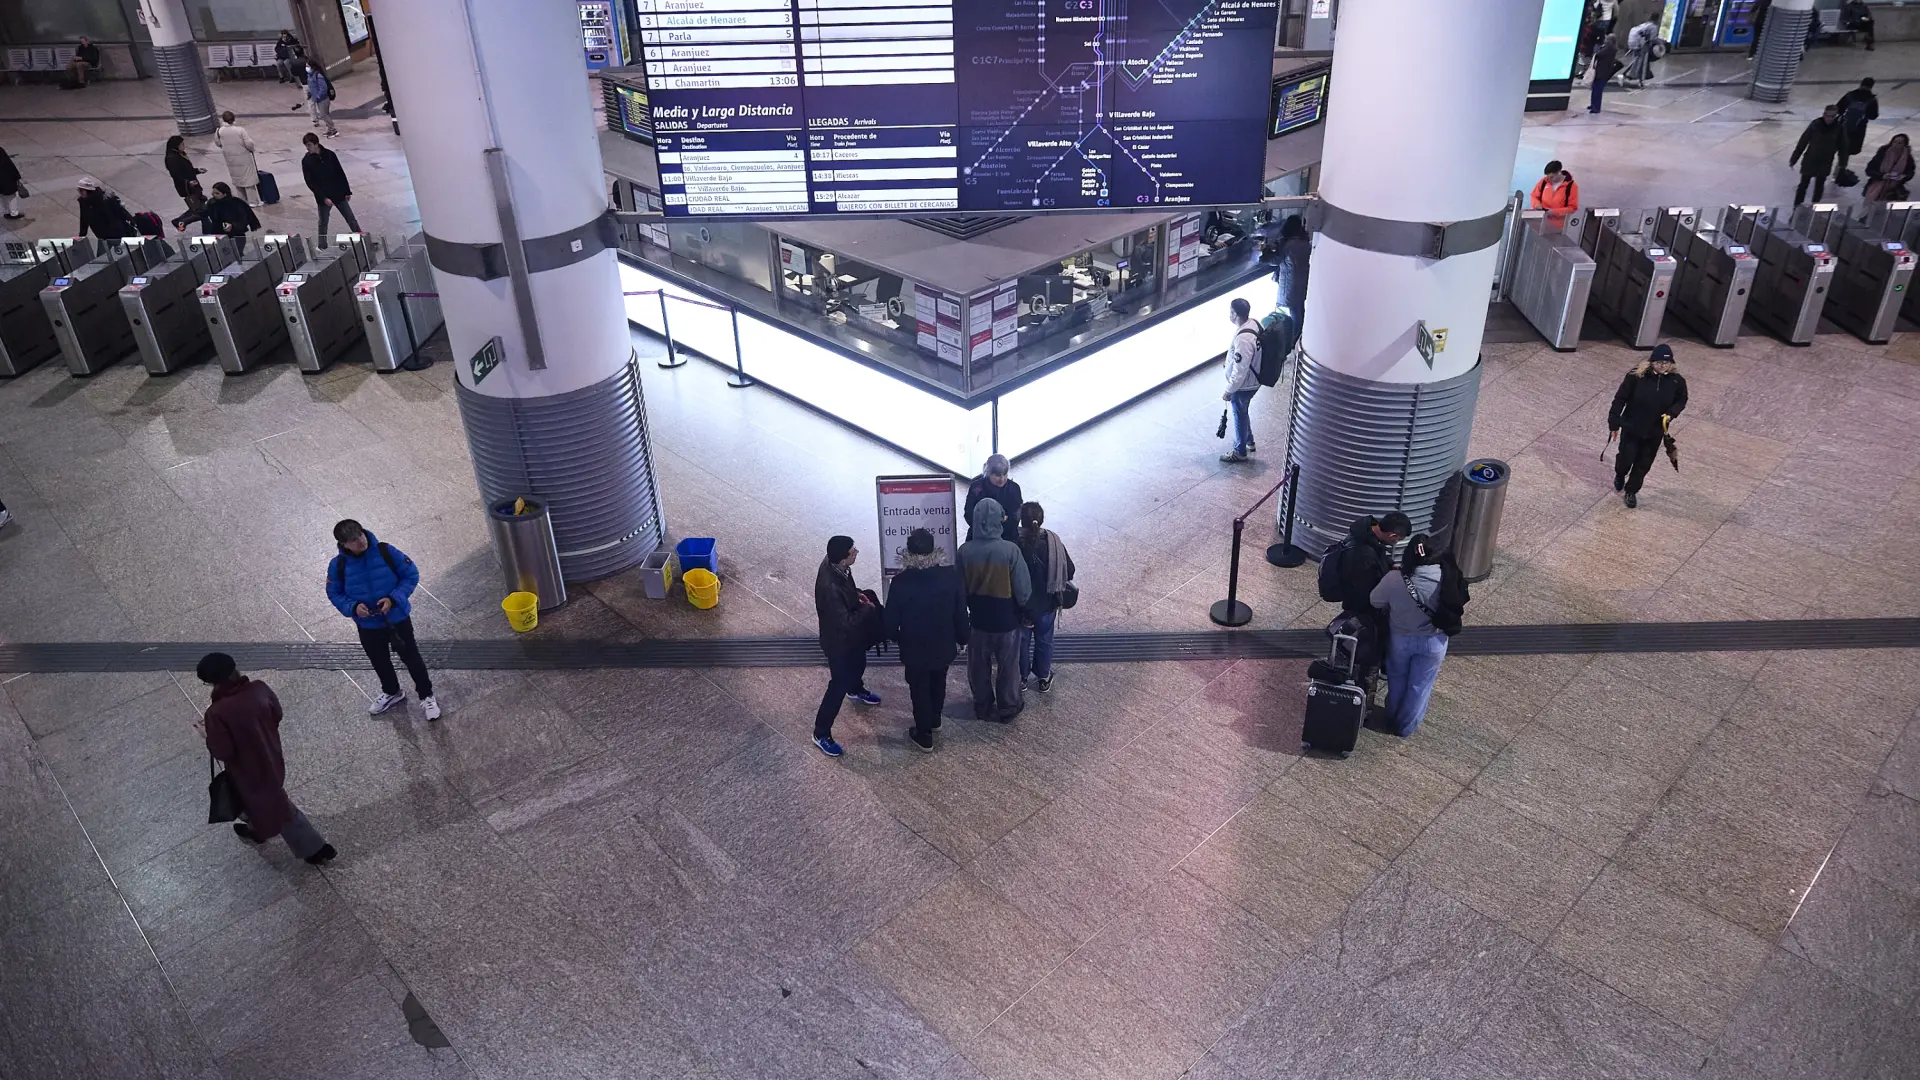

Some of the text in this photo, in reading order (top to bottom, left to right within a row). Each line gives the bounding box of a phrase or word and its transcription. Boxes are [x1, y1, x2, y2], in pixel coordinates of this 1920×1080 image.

[644, 1, 648, 10] 7
[665, 0, 704, 11] Aranjuez
[646, 17, 651, 25] 3
[697, 16, 708, 24] de
[711, 15, 746, 24] Henares
[785, 14, 790, 22] 3
[648, 29, 792, 41] 7 Parla 5
[651, 48, 710, 58] 6 Aranjuez
[653, 63, 711, 74] 7 Aranjuez
[770, 76, 795, 85] 13:06
[653, 104, 793, 120] Media y Larga Distancia
[655, 121, 688, 130] SALIDAS
[808, 118, 849, 126] LLEGADAS
[884, 506, 950, 516] Entrada venta
[885, 526, 897, 536] de
[938, 525, 950, 534] de
